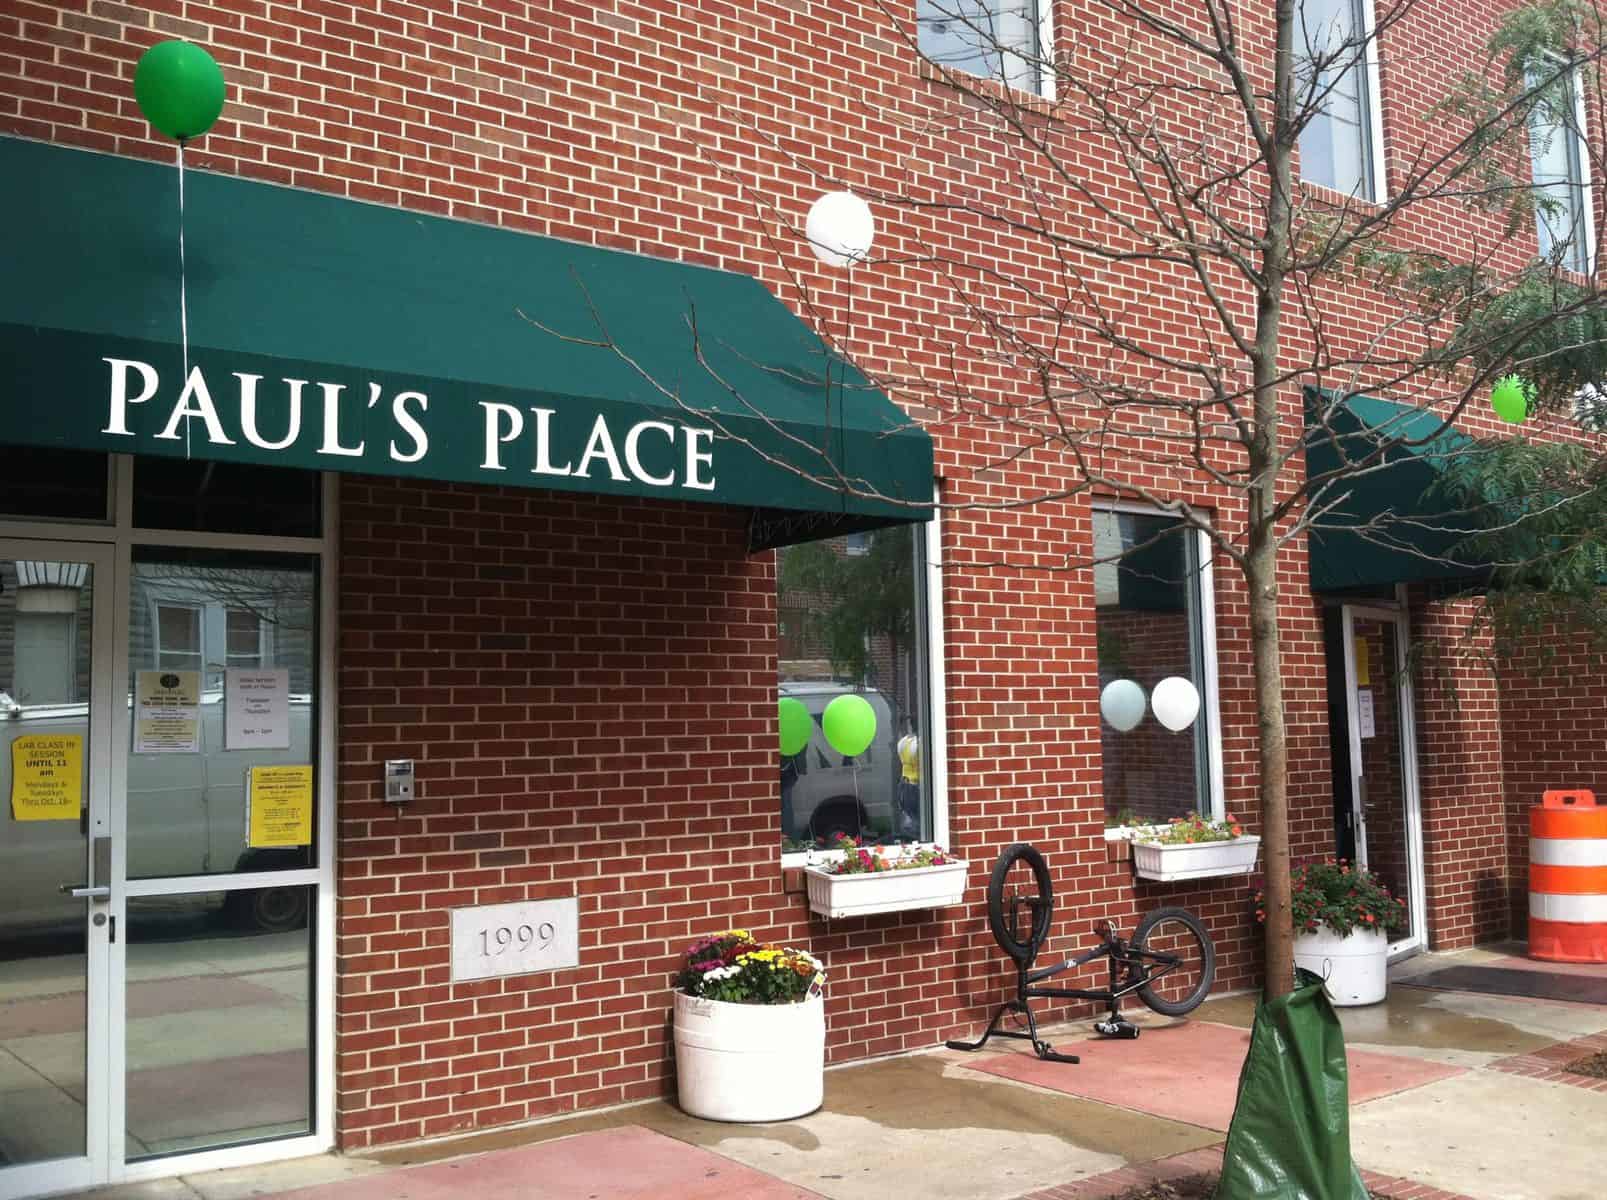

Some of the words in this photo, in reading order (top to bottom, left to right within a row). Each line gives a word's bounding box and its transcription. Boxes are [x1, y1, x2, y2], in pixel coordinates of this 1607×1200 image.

[101, 356, 430, 463] PAUL'S
[477, 400, 717, 492] PLACE
[18, 741, 36, 749] LAB
[37, 740, 65, 749] CLASS
[29, 750, 65, 758] SESSION
[25, 760, 53, 768] UNTIL
[480, 922, 555, 957] 1999
